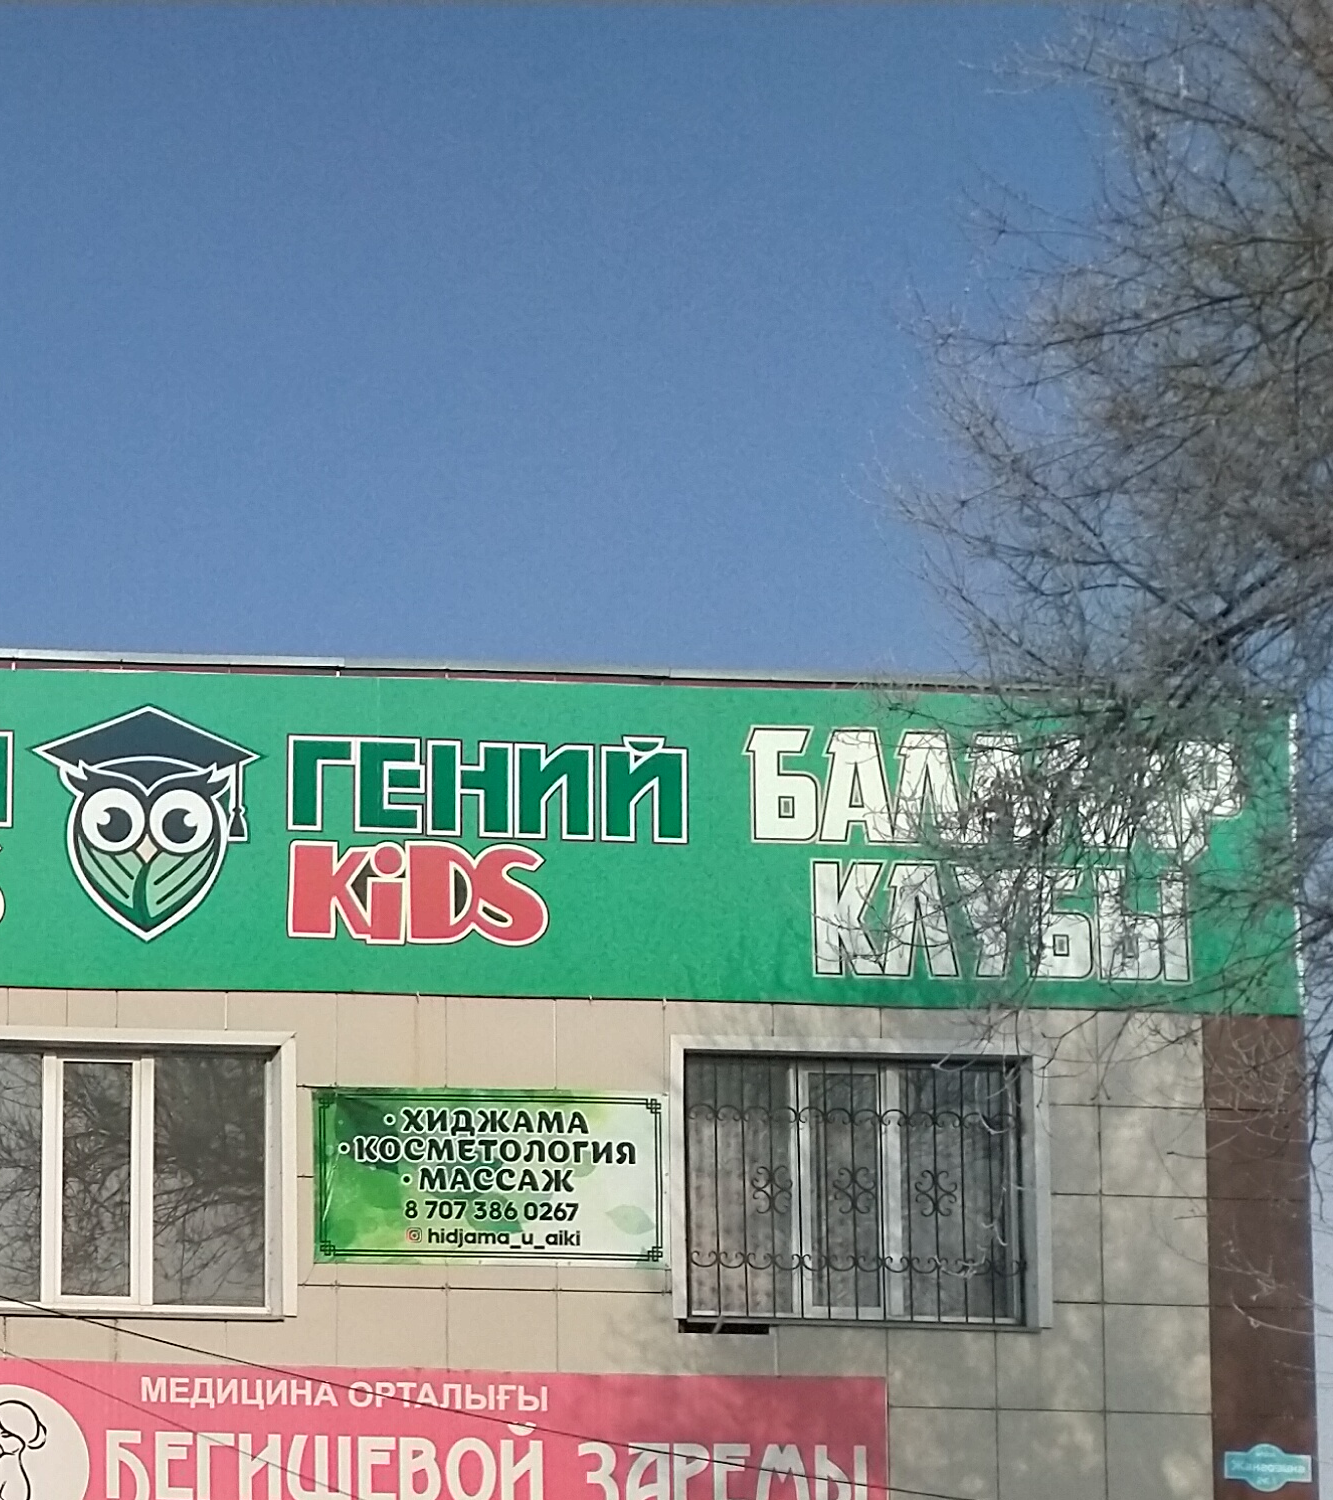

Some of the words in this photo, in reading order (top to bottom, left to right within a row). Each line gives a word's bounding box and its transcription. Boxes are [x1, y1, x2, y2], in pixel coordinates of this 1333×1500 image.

[286, 733, 689, 845] ГЕНИЙ
[741, 725, 1243, 863] БАЛАР
[286, 839, 551, 948] KiDS
[809, 858, 1194, 985] КЛУБЫ
[402, 1108, 590, 1137] ХИДЖАМА
[354, 1137, 637, 1165] КОСМЕТОЛОГИЯ
[419, 1167, 575, 1193] МАССАЖ
[404, 1200, 418, 1219] 8
[425, 1200, 467, 1220] 707
[473, 1201, 519, 1220] 386
[523, 1202, 579, 1222] 0267
[427, 1228, 581, 1250] hidjama_u_aiki
[140, 1376, 344, 1410] МЕДИЦИНА
[348, 1381, 549, 1412] ОРТАЛЫҒЫ
